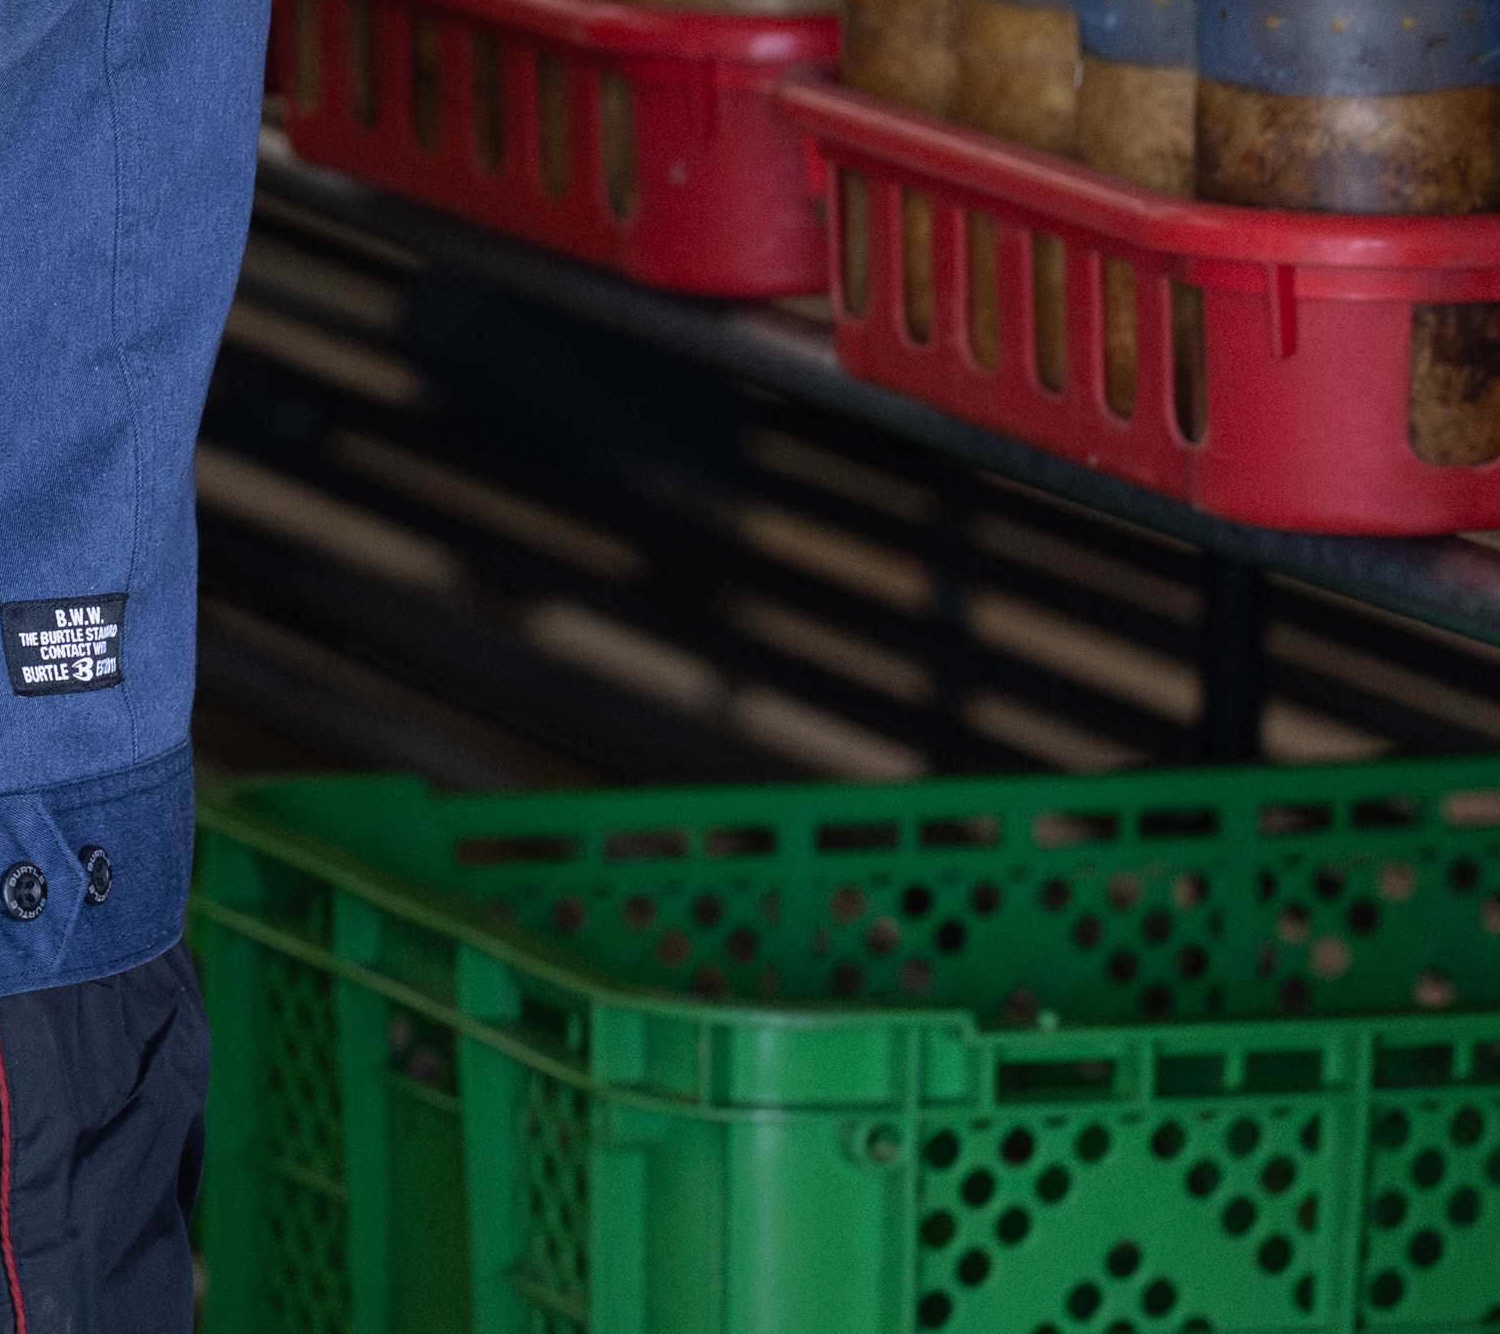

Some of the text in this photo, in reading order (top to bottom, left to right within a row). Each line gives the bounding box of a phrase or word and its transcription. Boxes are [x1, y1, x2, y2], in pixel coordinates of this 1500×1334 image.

[55, 606, 104, 627] B.W.W.
[18, 632, 38, 647] THE
[40, 628, 83, 645] BURTLE
[40, 642, 91, 660] CONTACT
[22, 663, 70, 683] BURTLE
[9, 865, 45, 887] BURTLE
[10, 897, 46, 919] BURTLE
